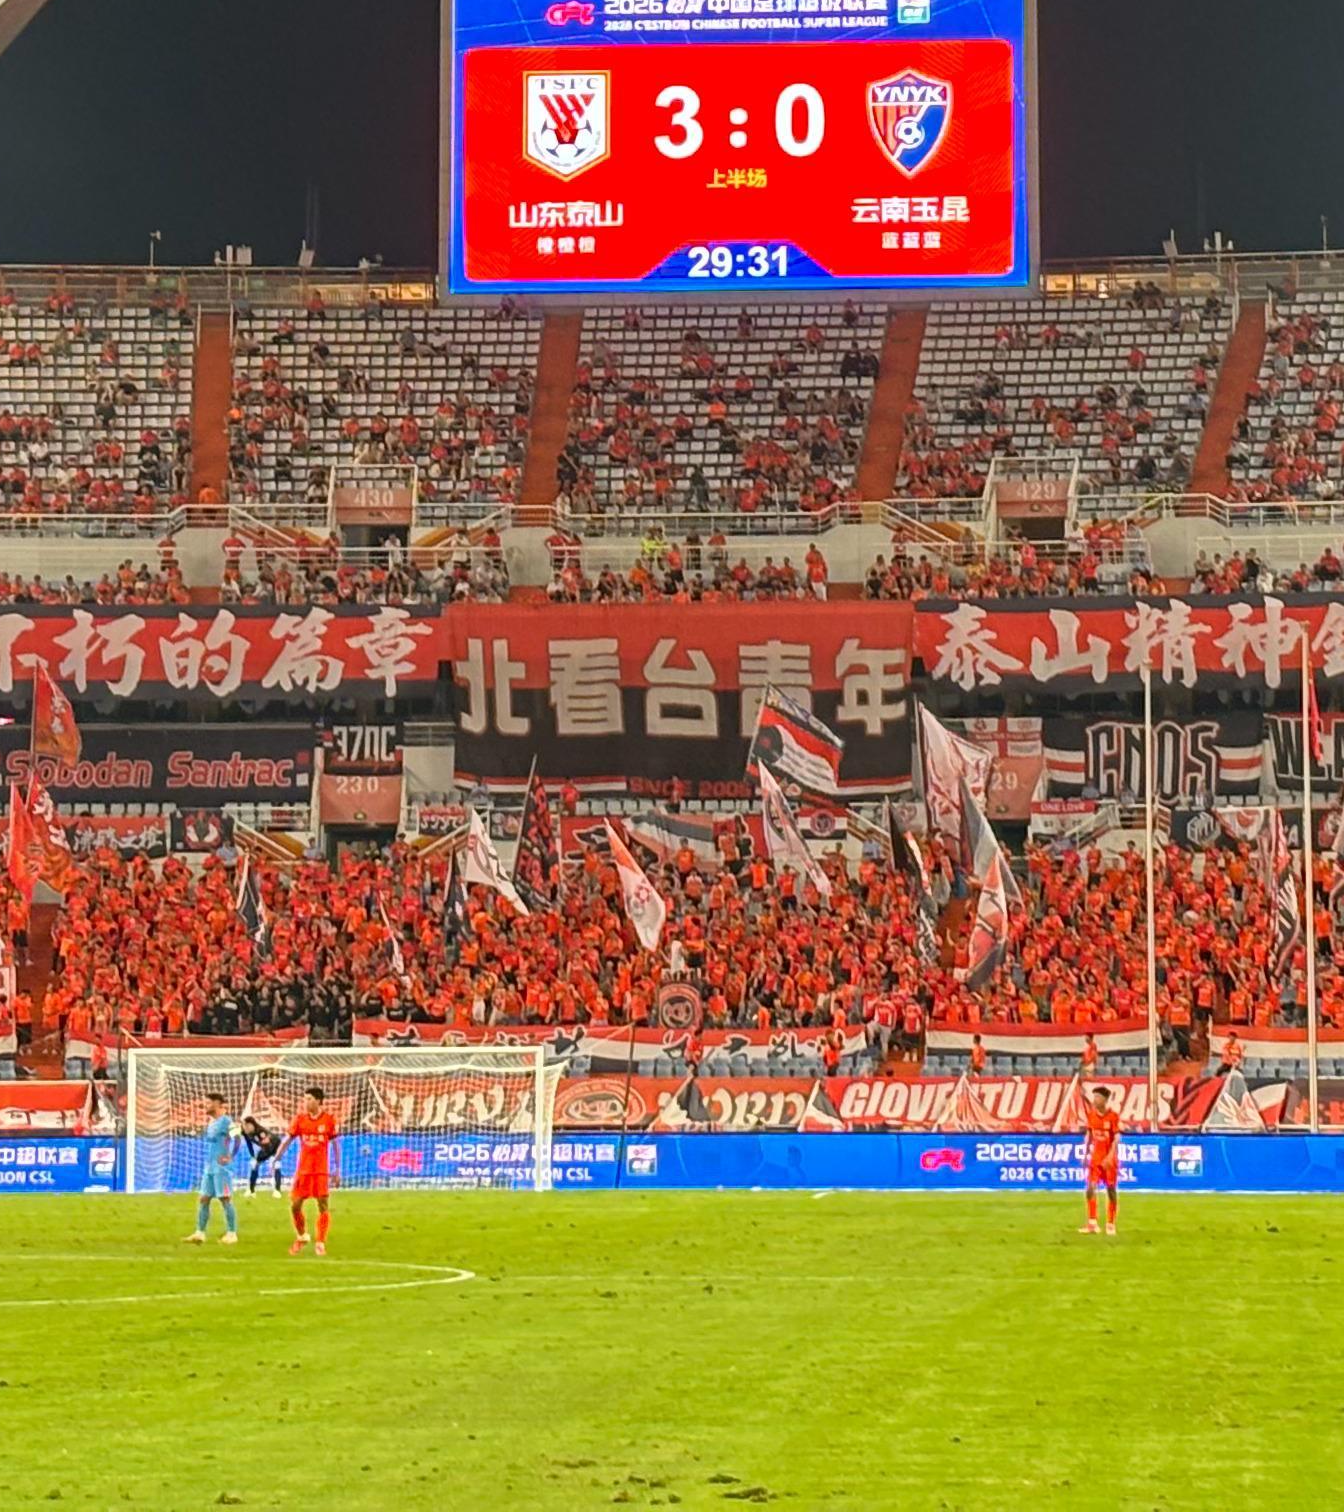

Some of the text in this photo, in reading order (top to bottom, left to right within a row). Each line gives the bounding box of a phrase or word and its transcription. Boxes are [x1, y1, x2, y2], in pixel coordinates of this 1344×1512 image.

[741, 16, 802, 30] FOOTBALL
[842, 15, 889, 28] LEAGUE
[873, 86, 945, 102] YNYK
[706, 168, 768, 189] 上半场
[509, 201, 624, 228] 山东泰山
[851, 196, 970, 223] 云南玉昆
[688, 245, 788, 277] 29:31
[354, 489, 394, 507] 430
[457, 636, 909, 739] 北看台青年
[167, 750, 296, 788] Santrac
[336, 776, 379, 794] 230
[992, 772, 1018, 790] 29
[29, 1170, 56, 1184] CSL
[566, 1167, 593, 1181] CSL
[1000, 1167, 1034, 1181] 2026
